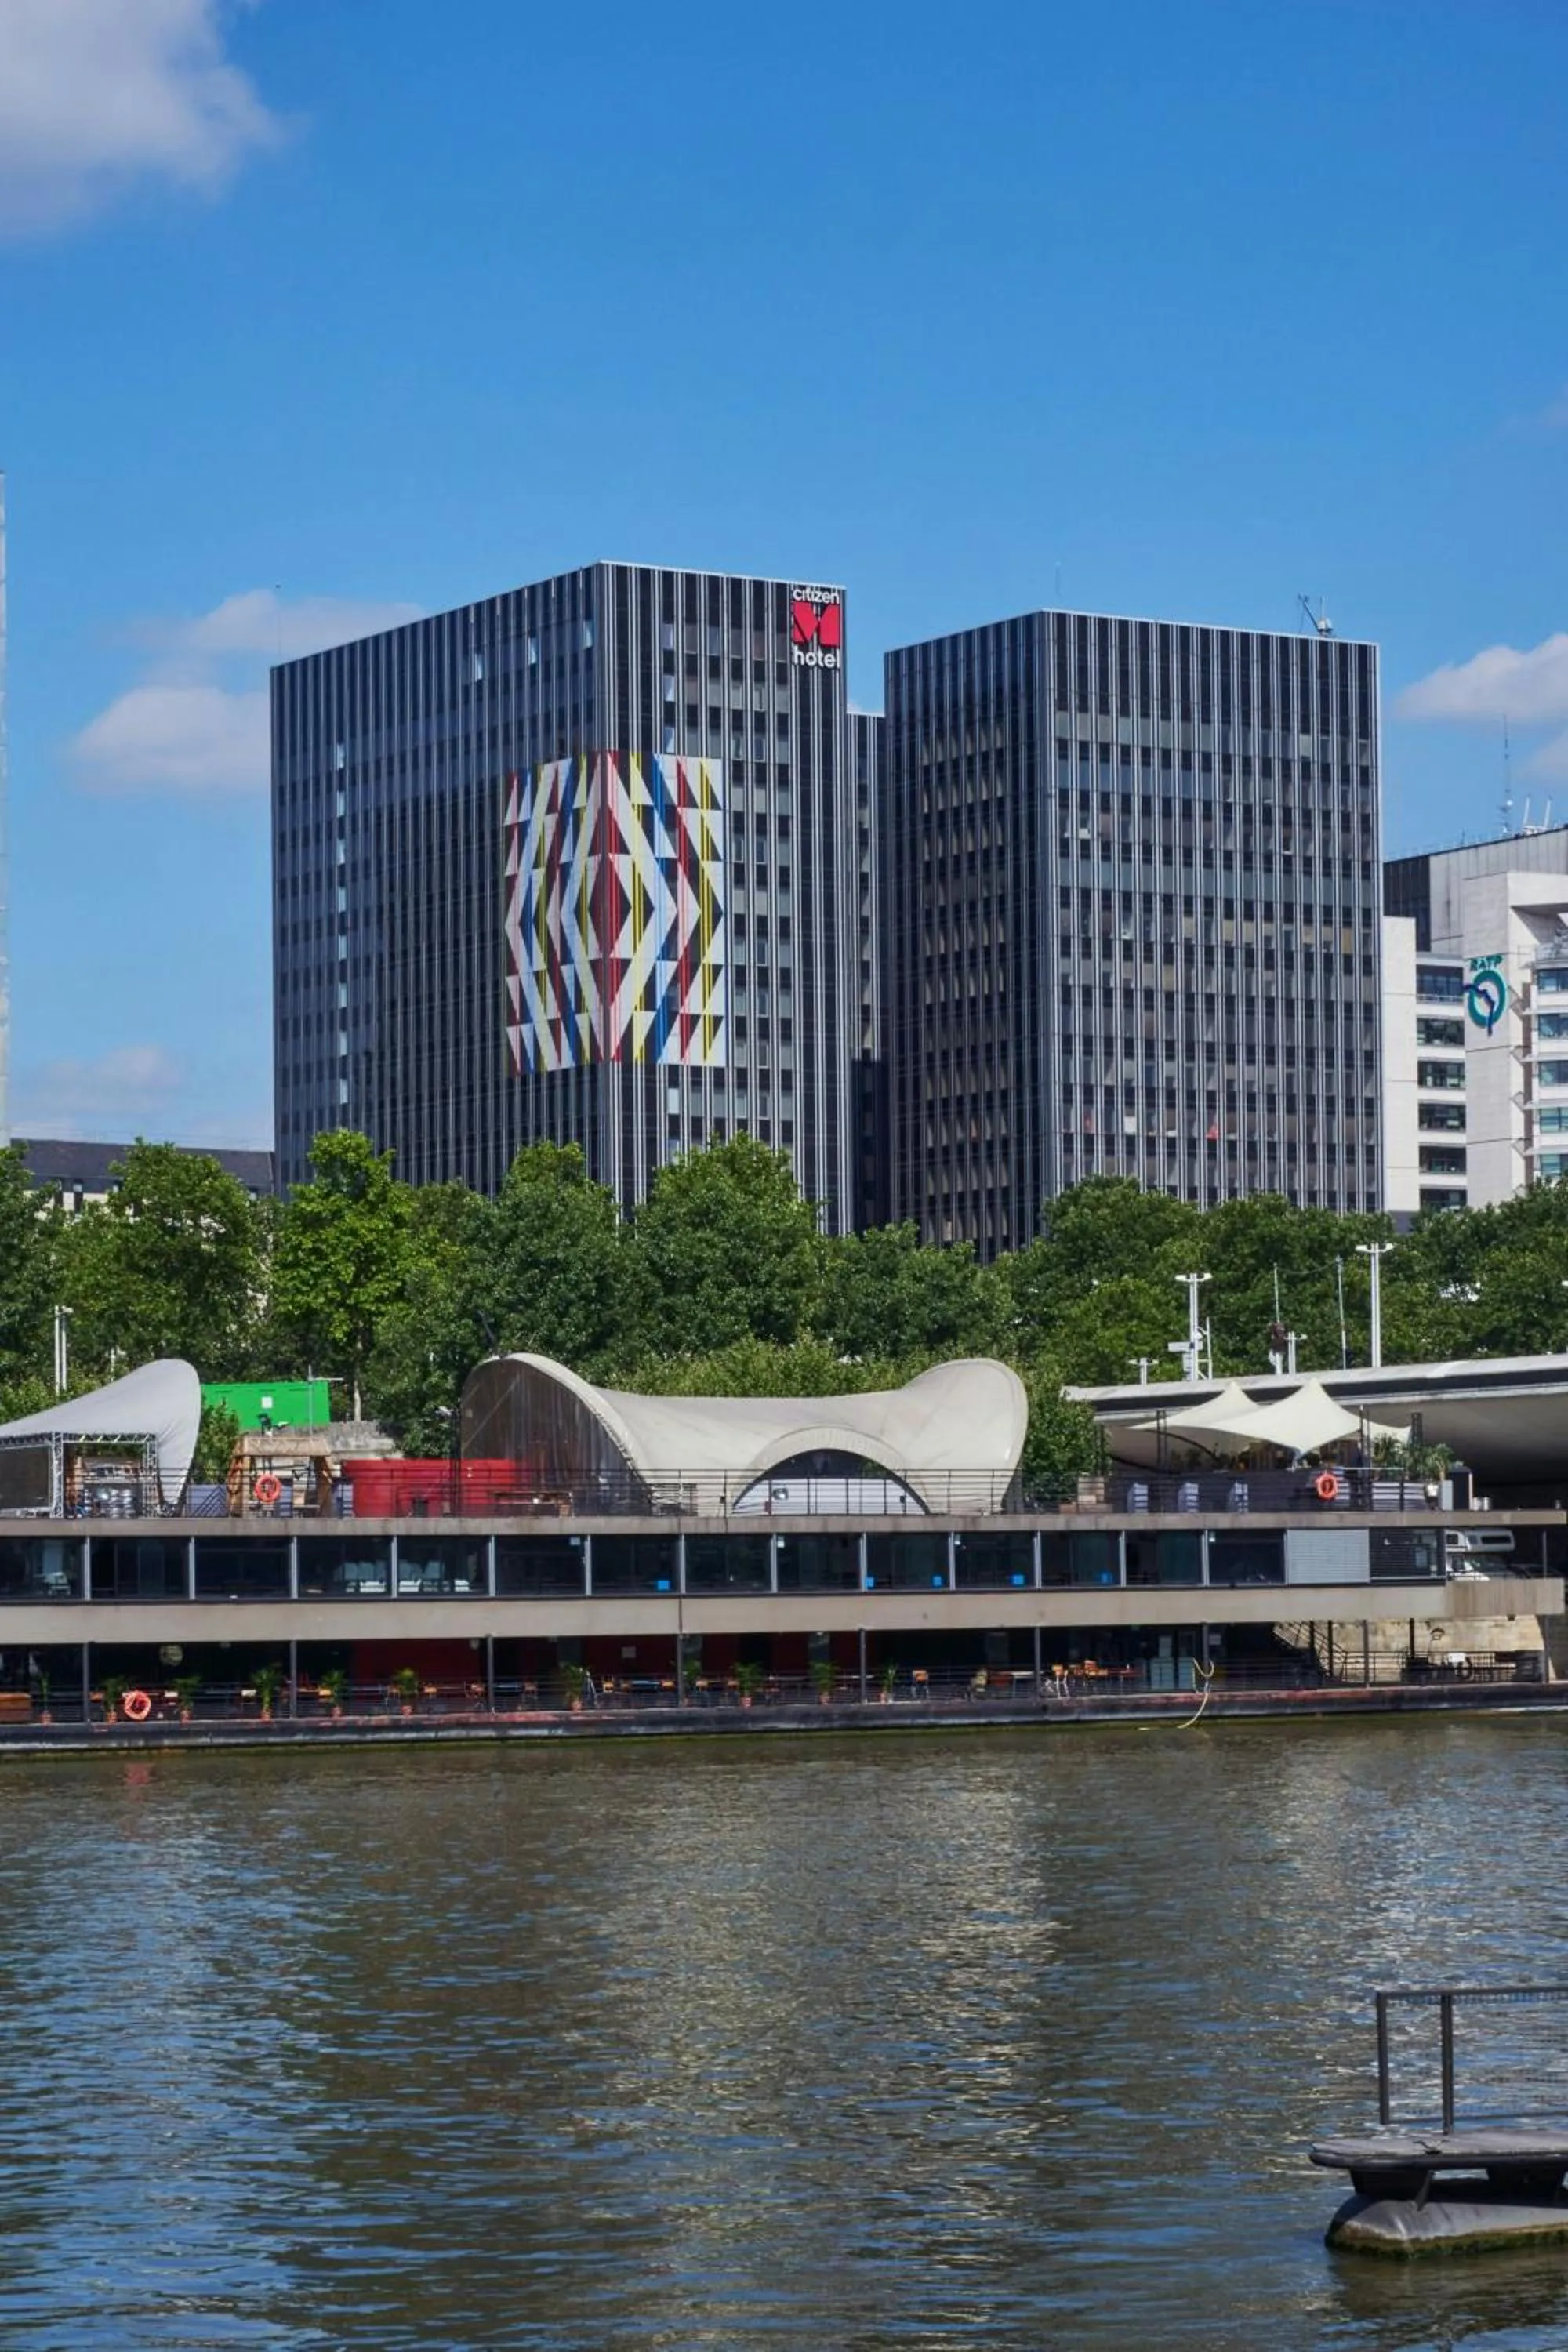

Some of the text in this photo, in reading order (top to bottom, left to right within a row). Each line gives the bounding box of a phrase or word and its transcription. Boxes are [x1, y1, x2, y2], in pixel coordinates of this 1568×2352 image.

[793, 586, 840, 604] citizen
[793, 644, 840, 668] hotel
[1469, 953, 1503, 971] RATP
